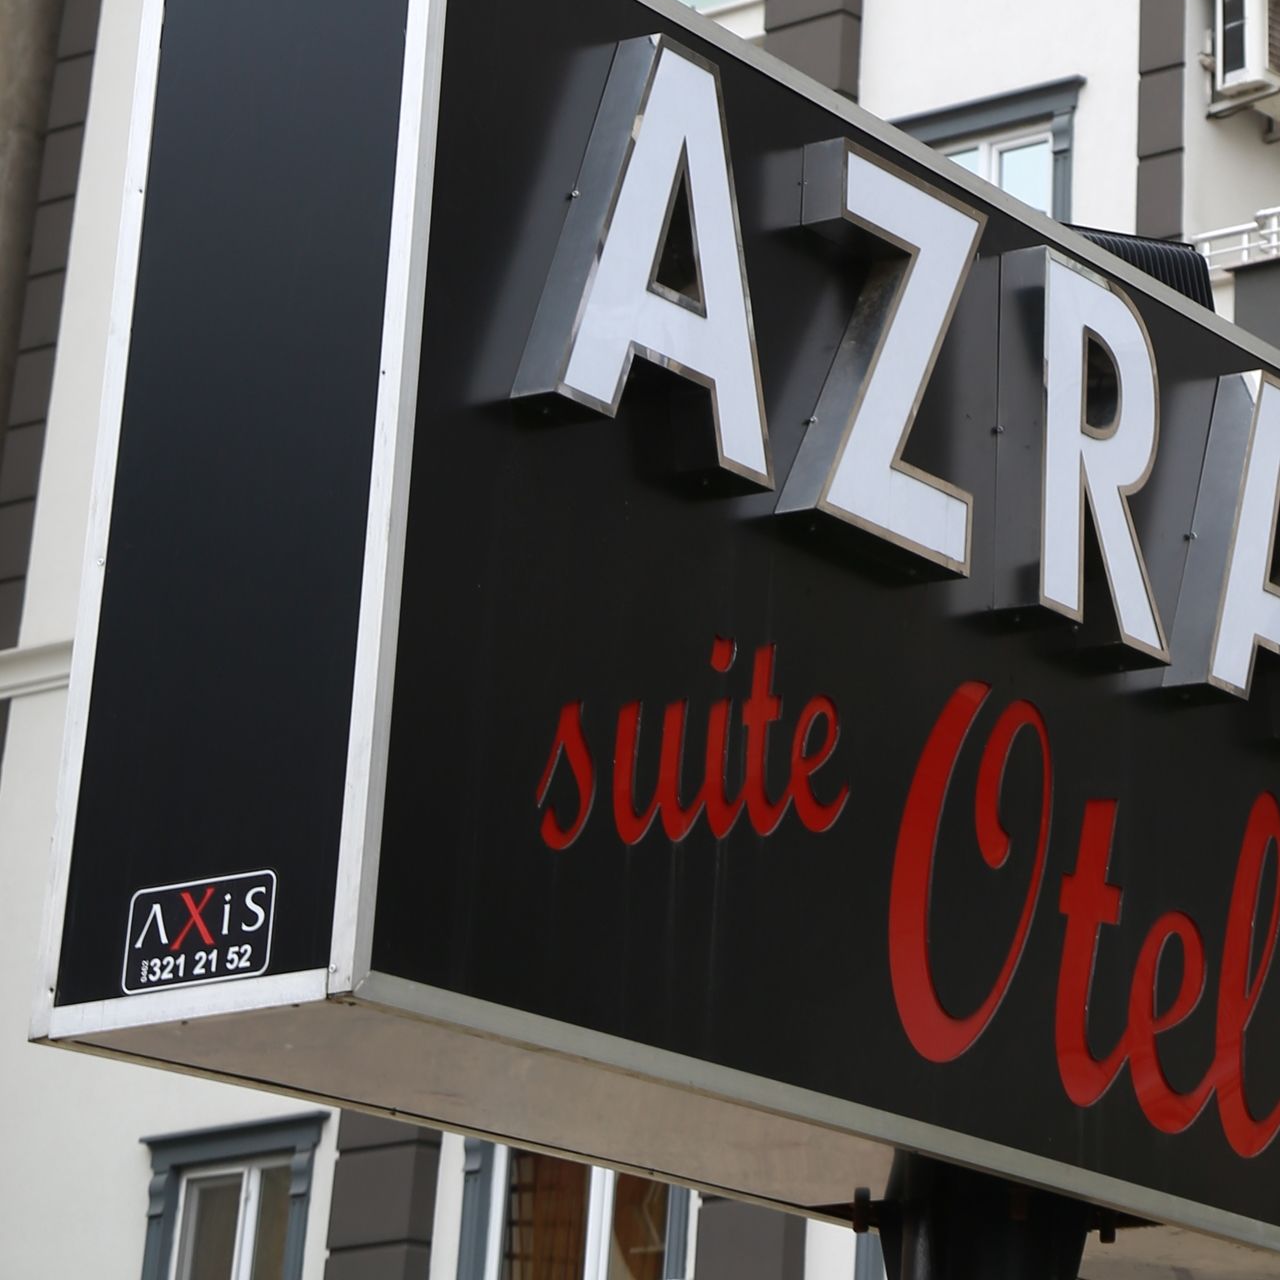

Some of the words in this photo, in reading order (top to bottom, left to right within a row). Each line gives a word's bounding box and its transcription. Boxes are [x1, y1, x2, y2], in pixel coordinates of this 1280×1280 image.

[535, 635, 850, 850] suite
[148, 954, 186, 982] 321
[193, 949, 218, 975] 21
[225, 944, 253, 970] 52
